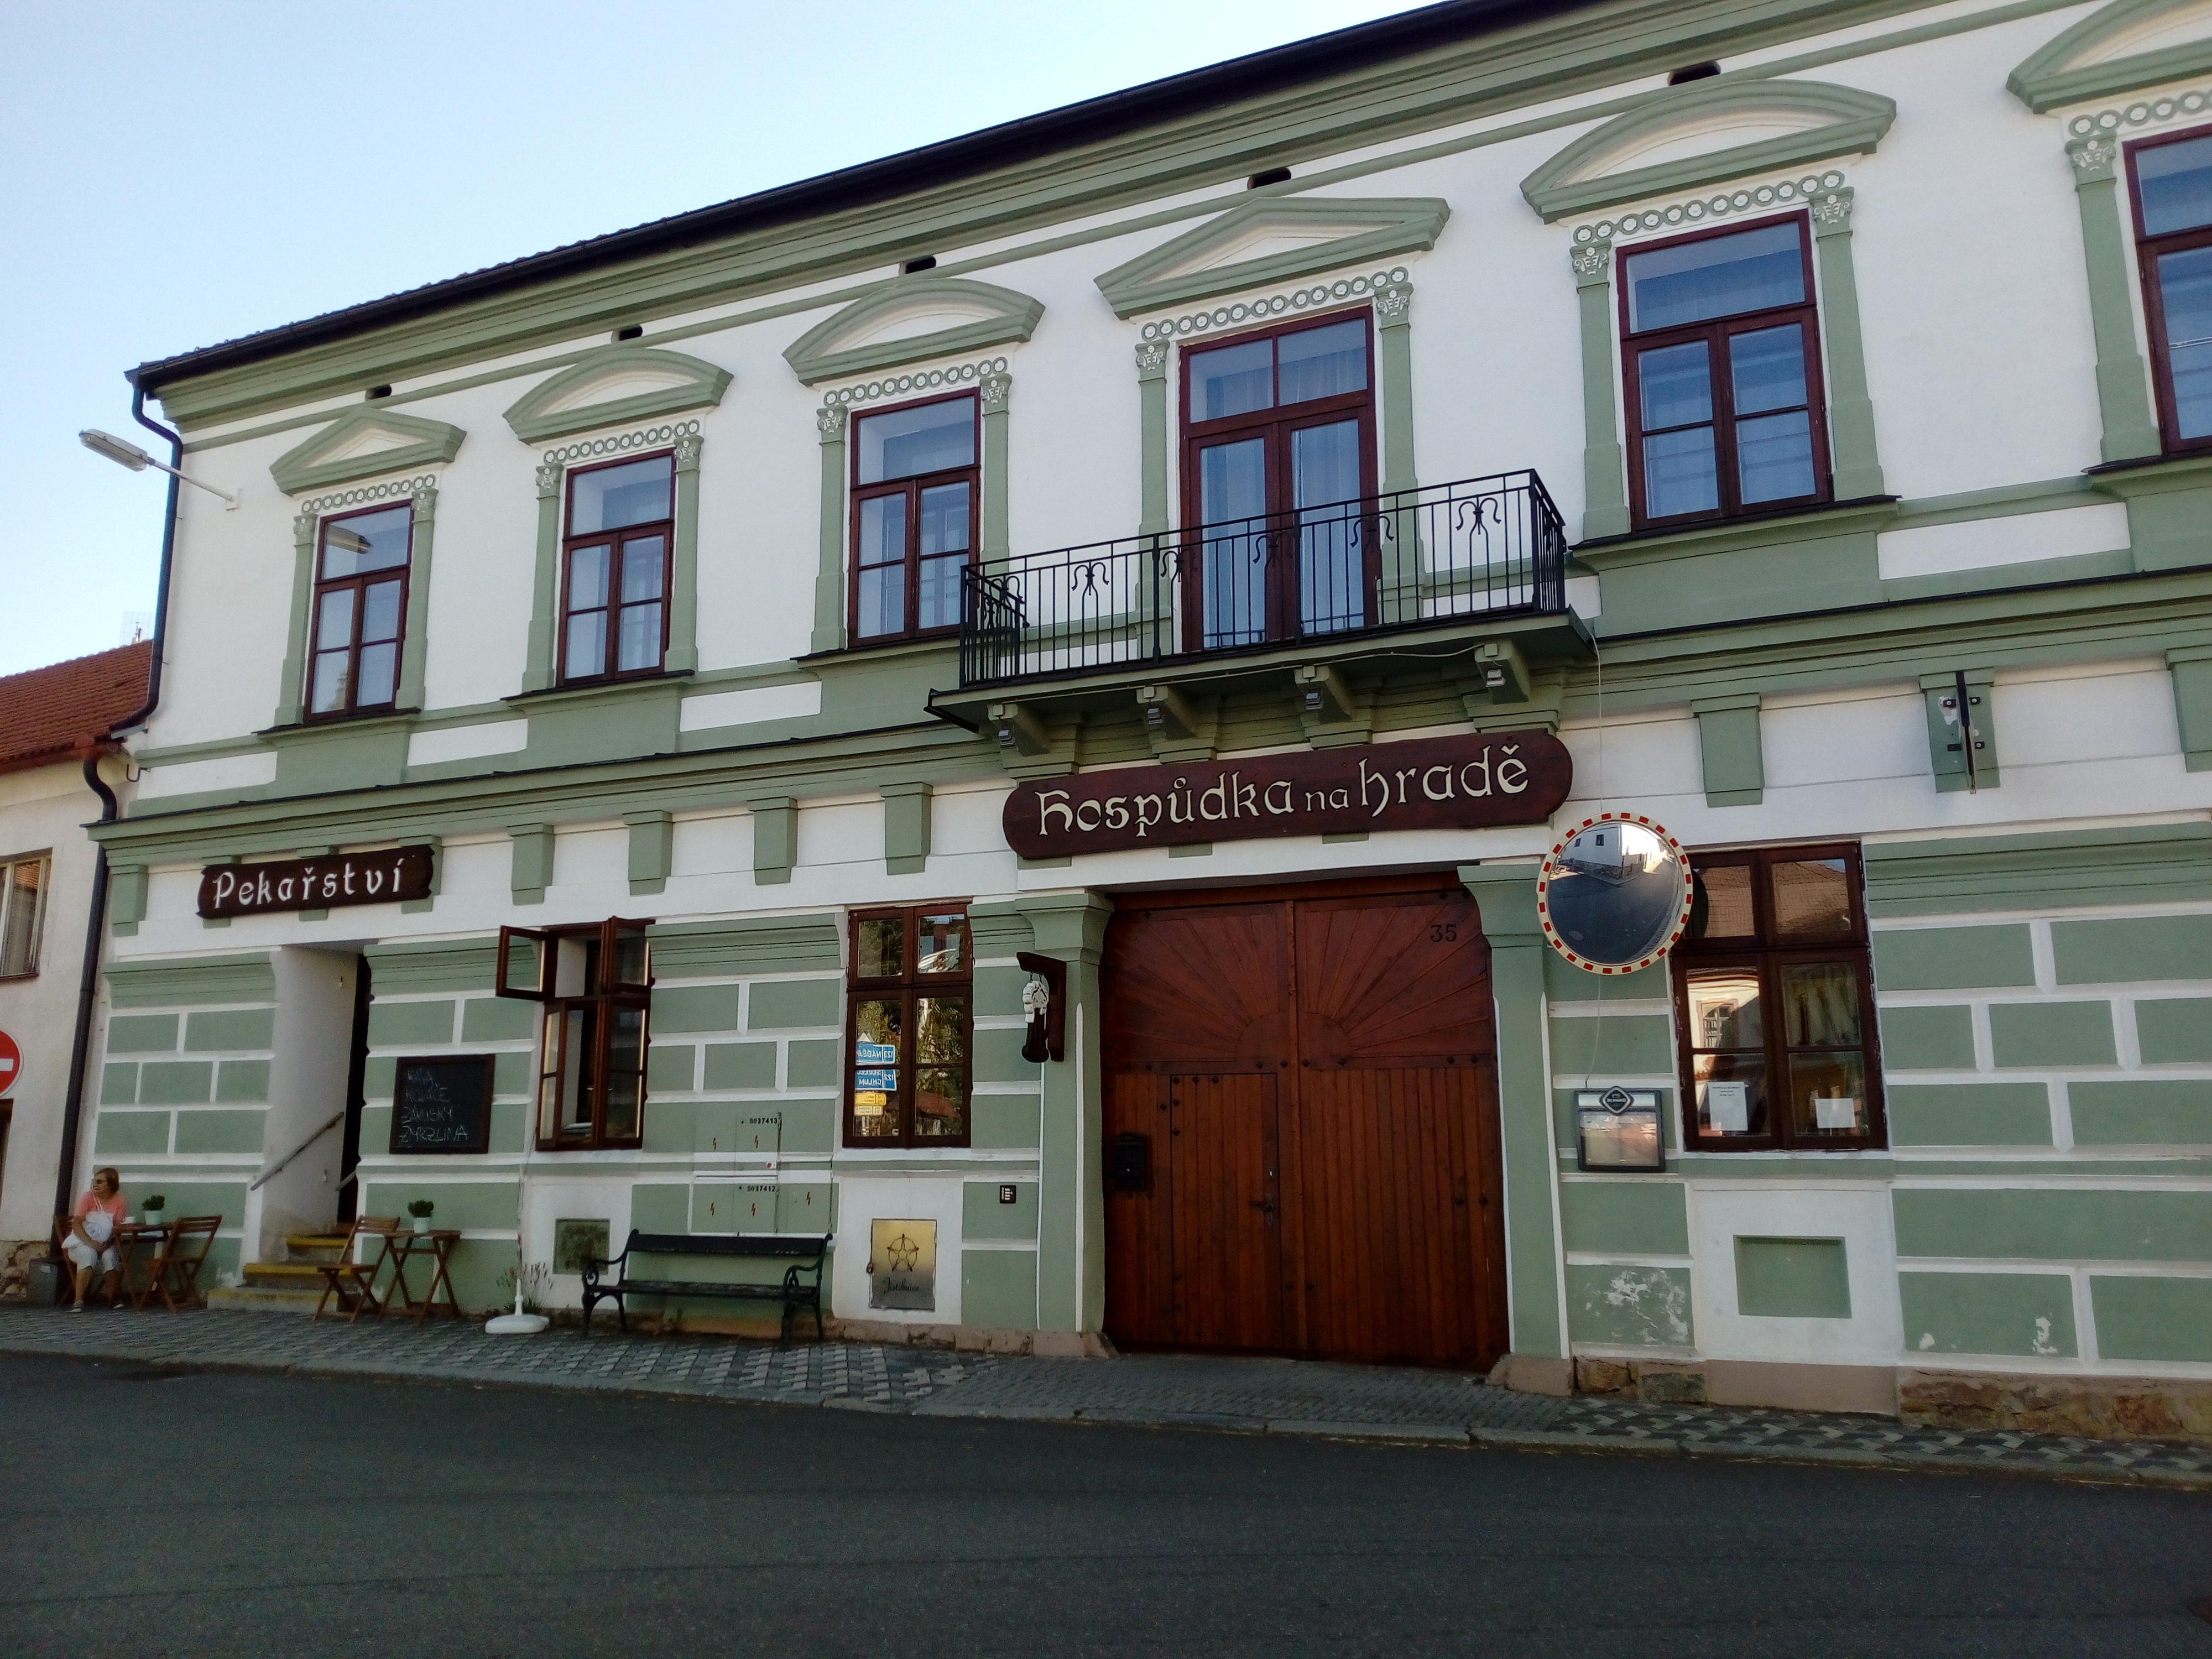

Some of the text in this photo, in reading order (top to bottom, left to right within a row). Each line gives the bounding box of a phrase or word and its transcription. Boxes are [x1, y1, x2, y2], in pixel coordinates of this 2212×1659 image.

[1034, 744, 1528, 837] Hospůdka na hradě
[212, 858, 404, 909] Pekařství
[1430, 924, 1457, 942] 35
